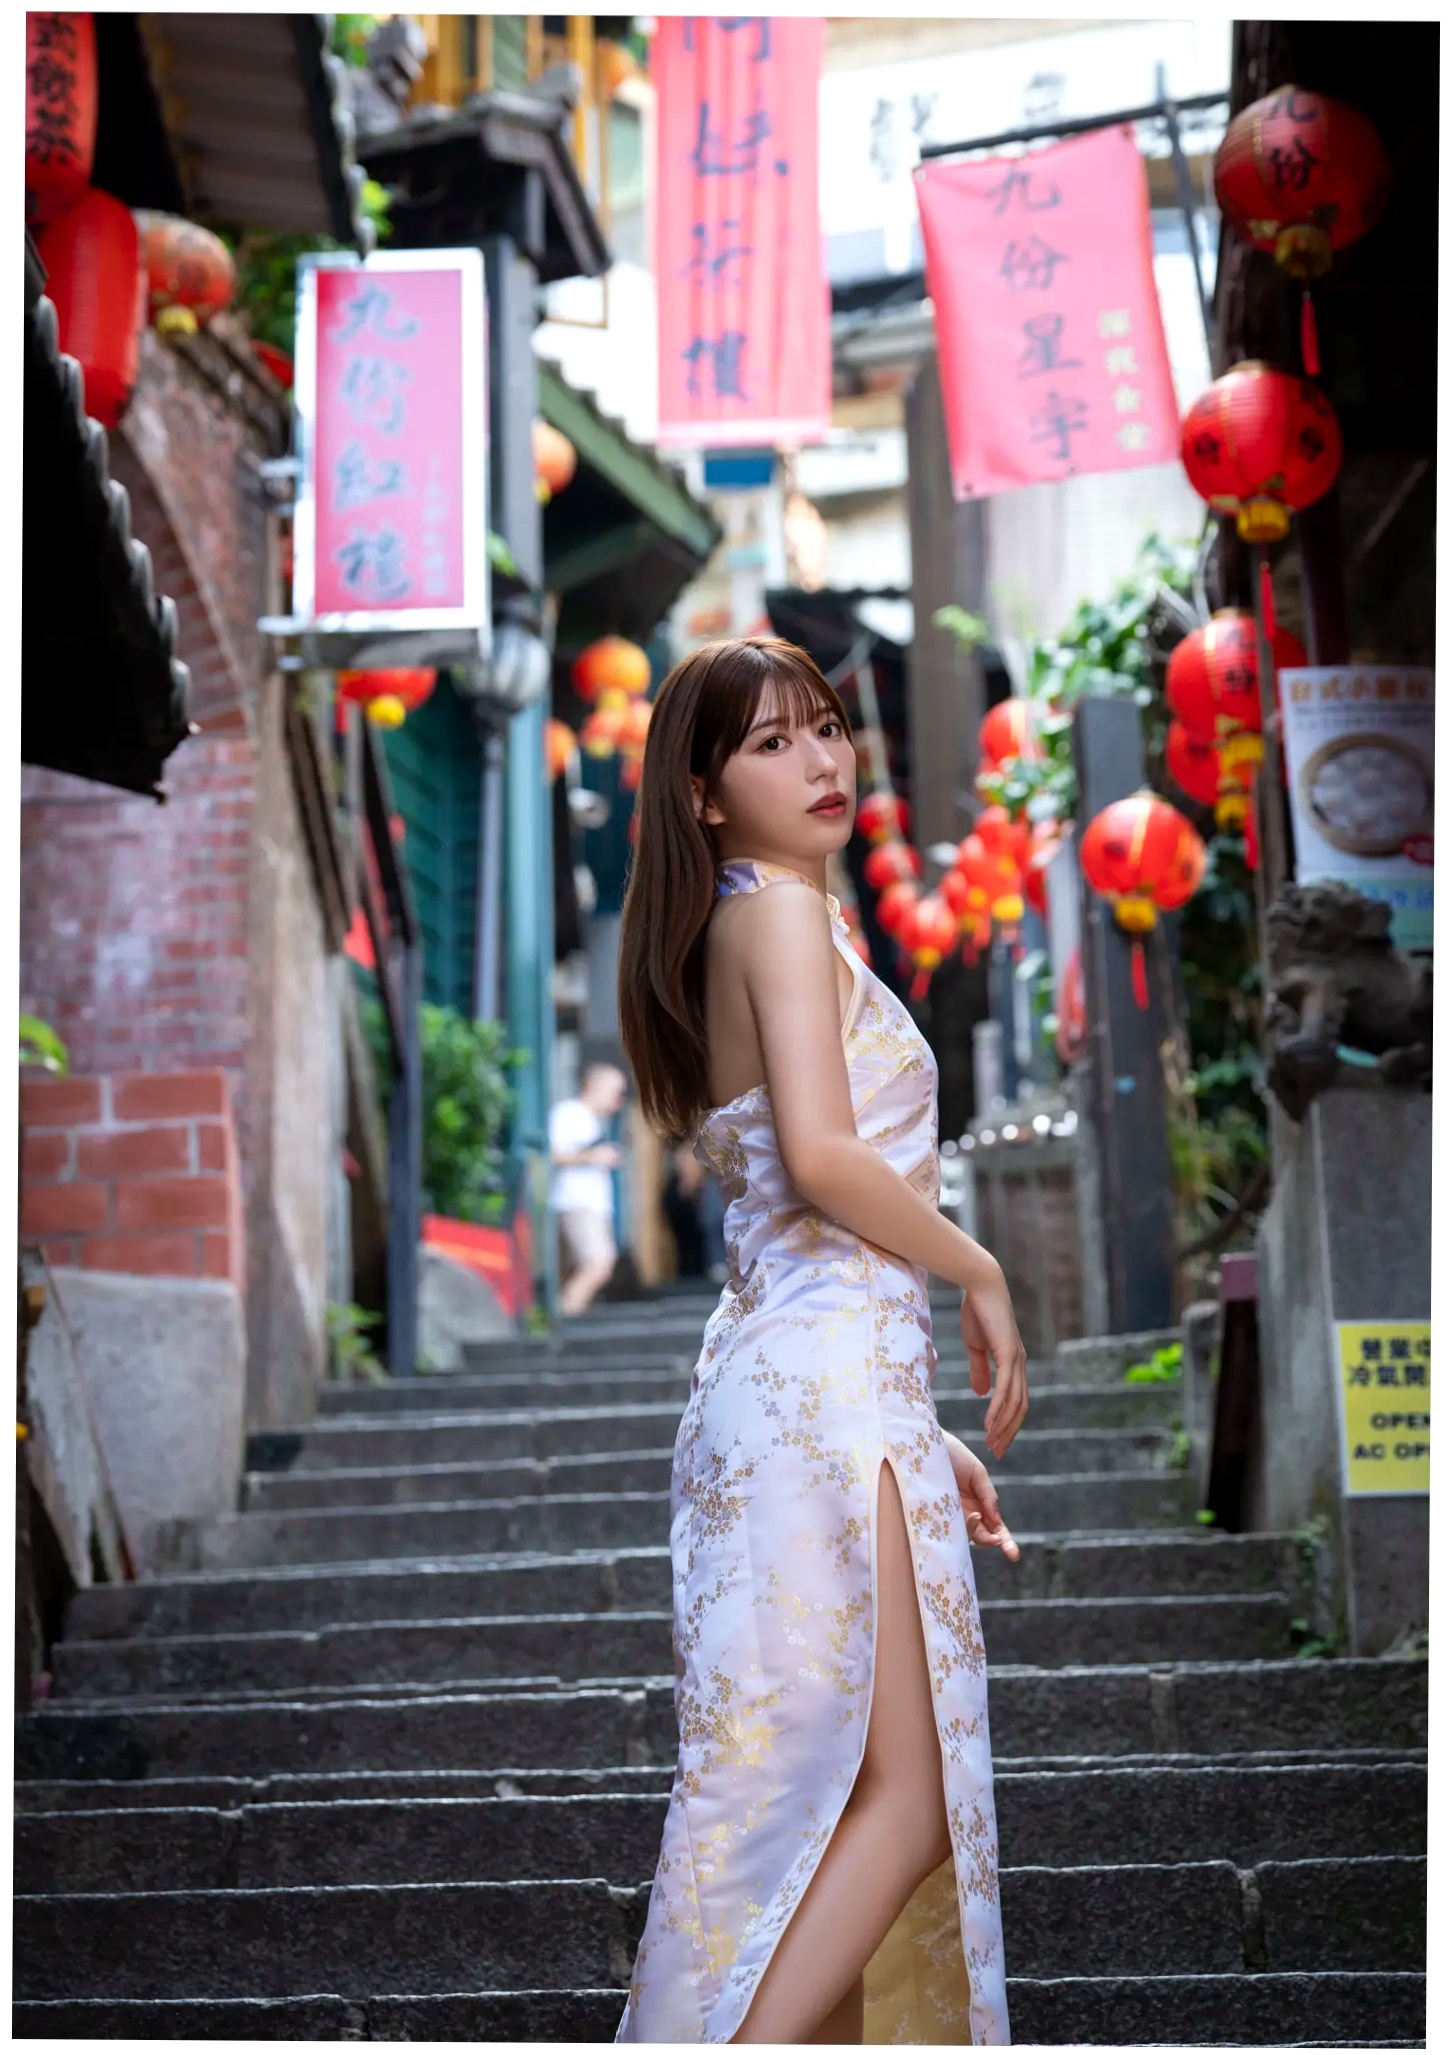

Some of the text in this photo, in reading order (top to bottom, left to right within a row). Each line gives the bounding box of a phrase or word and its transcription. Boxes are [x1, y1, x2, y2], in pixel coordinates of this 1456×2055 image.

[1267, 91, 1318, 190] 九份
[985, 168, 1088, 461] 九份星宇
[1353, 1443, 1386, 1460] AC
